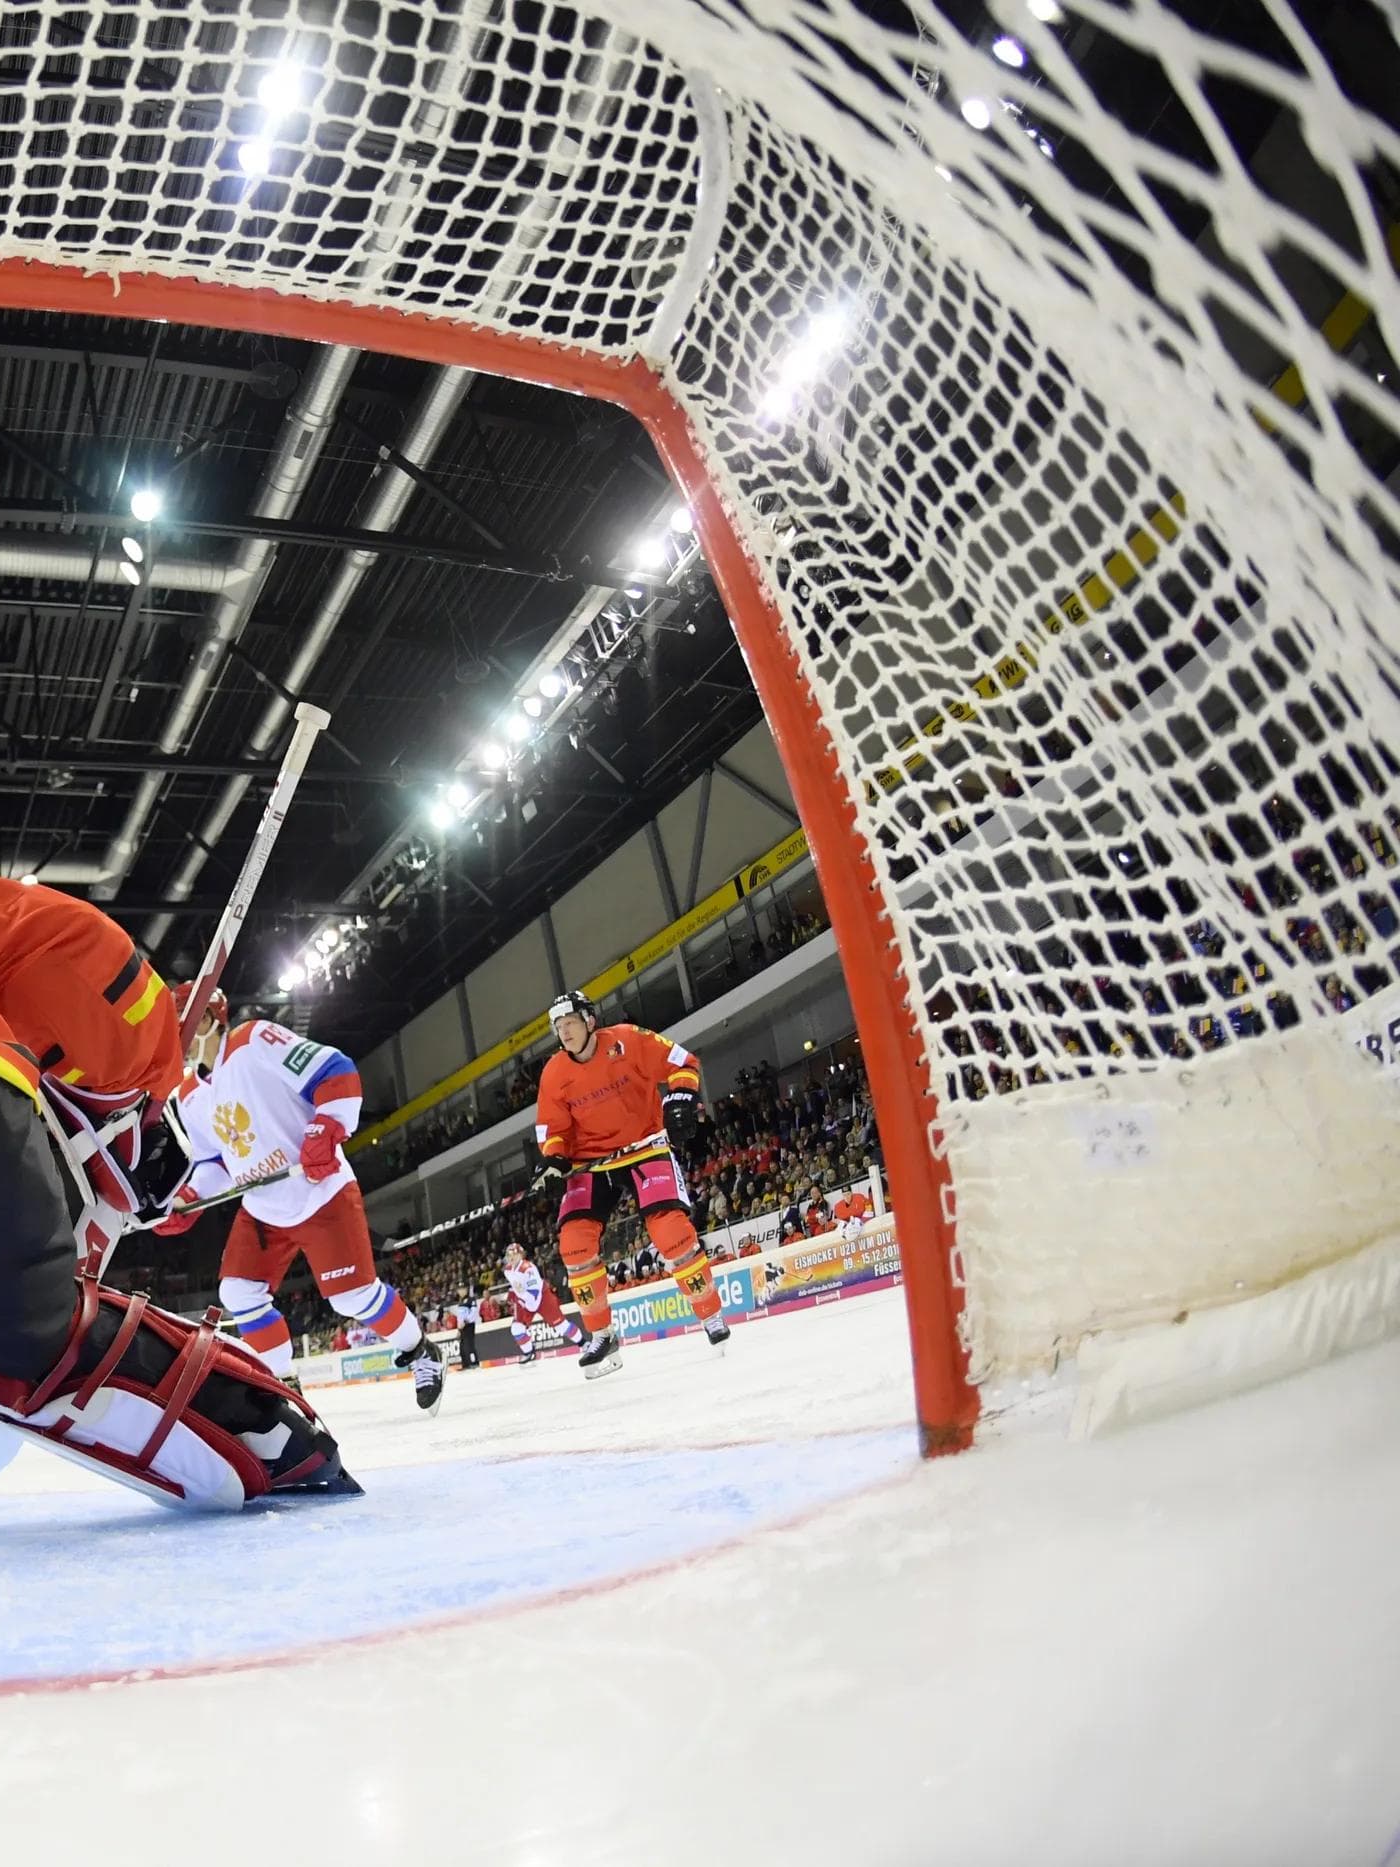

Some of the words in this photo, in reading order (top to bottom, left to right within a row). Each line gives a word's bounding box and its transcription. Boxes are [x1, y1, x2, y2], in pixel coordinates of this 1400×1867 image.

[776, 834, 807, 864] STADTW
[419, 1202, 495, 1239] EASTON
[794, 1248, 837, 1270] EISHOCKEY
[857, 1235, 875, 1251] WM
[320, 1264, 356, 1281] CCM
